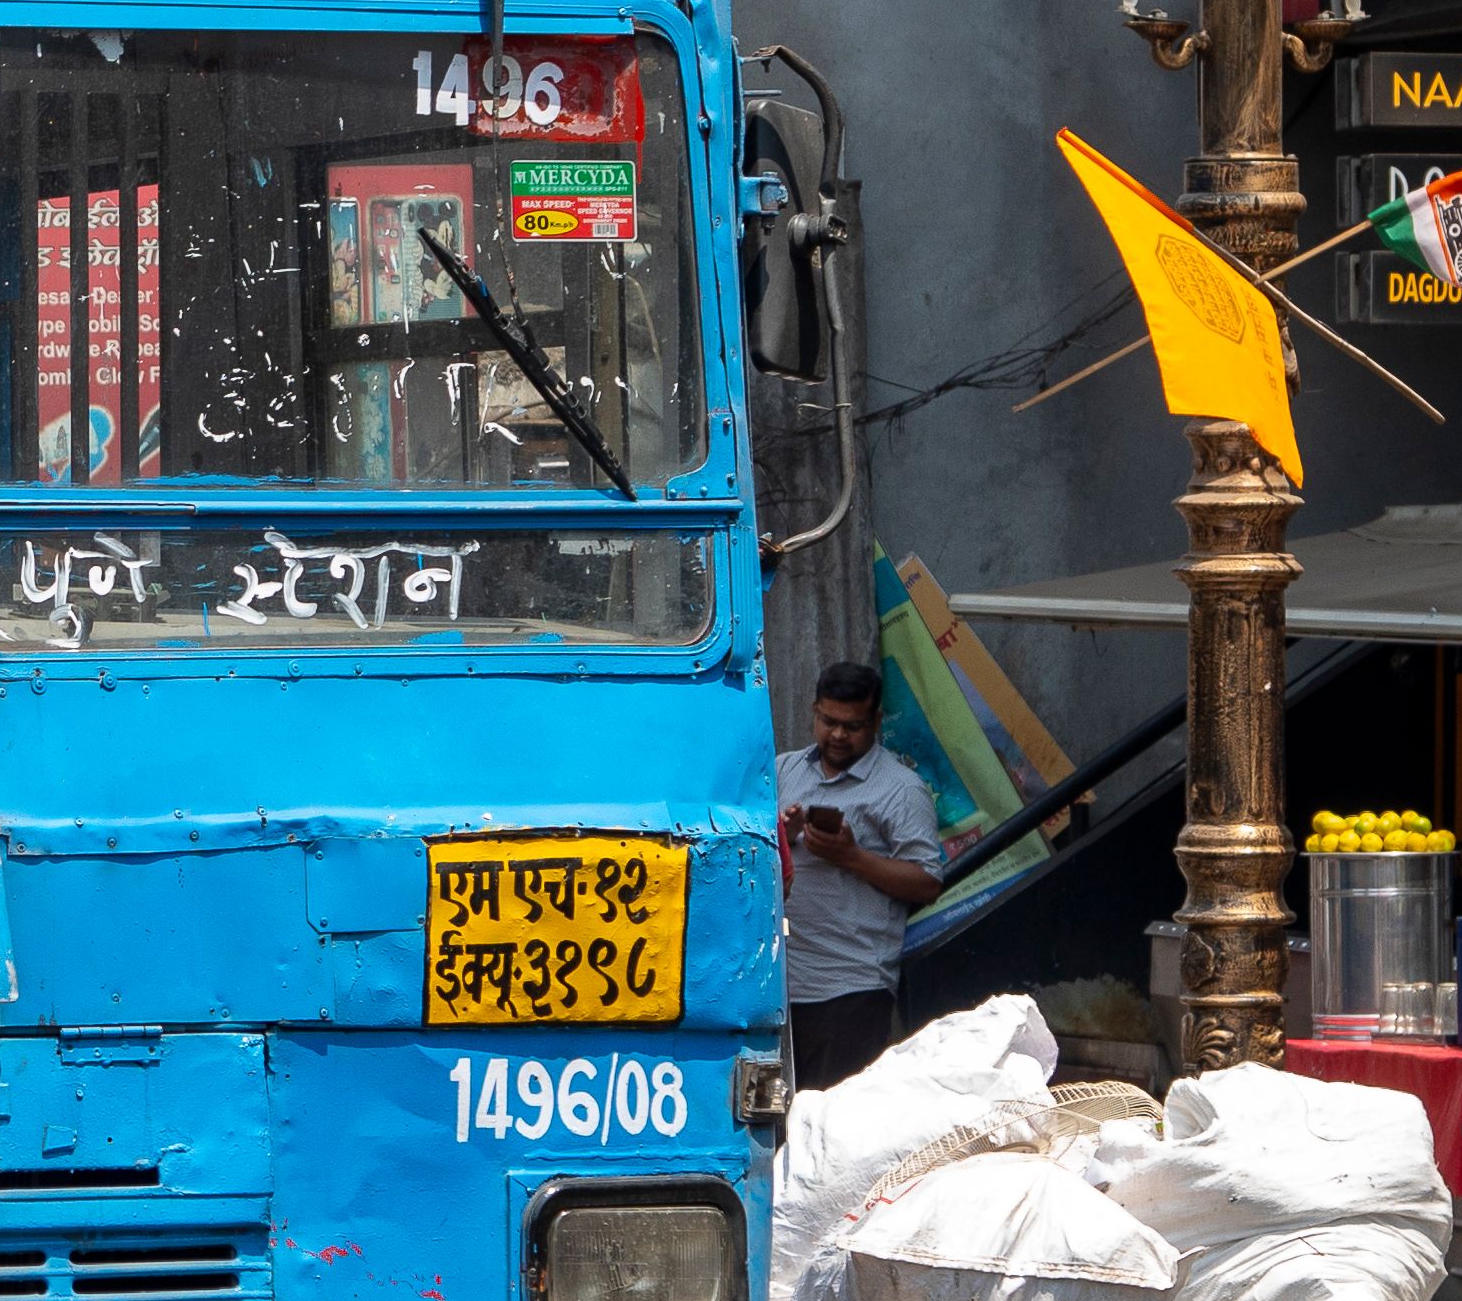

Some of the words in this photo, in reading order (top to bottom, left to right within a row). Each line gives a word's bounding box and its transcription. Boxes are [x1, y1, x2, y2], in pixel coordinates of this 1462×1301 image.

[411, 49, 565, 127] 1496
[528, 168, 630, 186] MERCYDA
[521, 200, 541, 209] MAX
[524, 215, 549, 231] 80
[435, 860, 505, 928] एम
[450, 1051, 688, 1147] 1496/08
